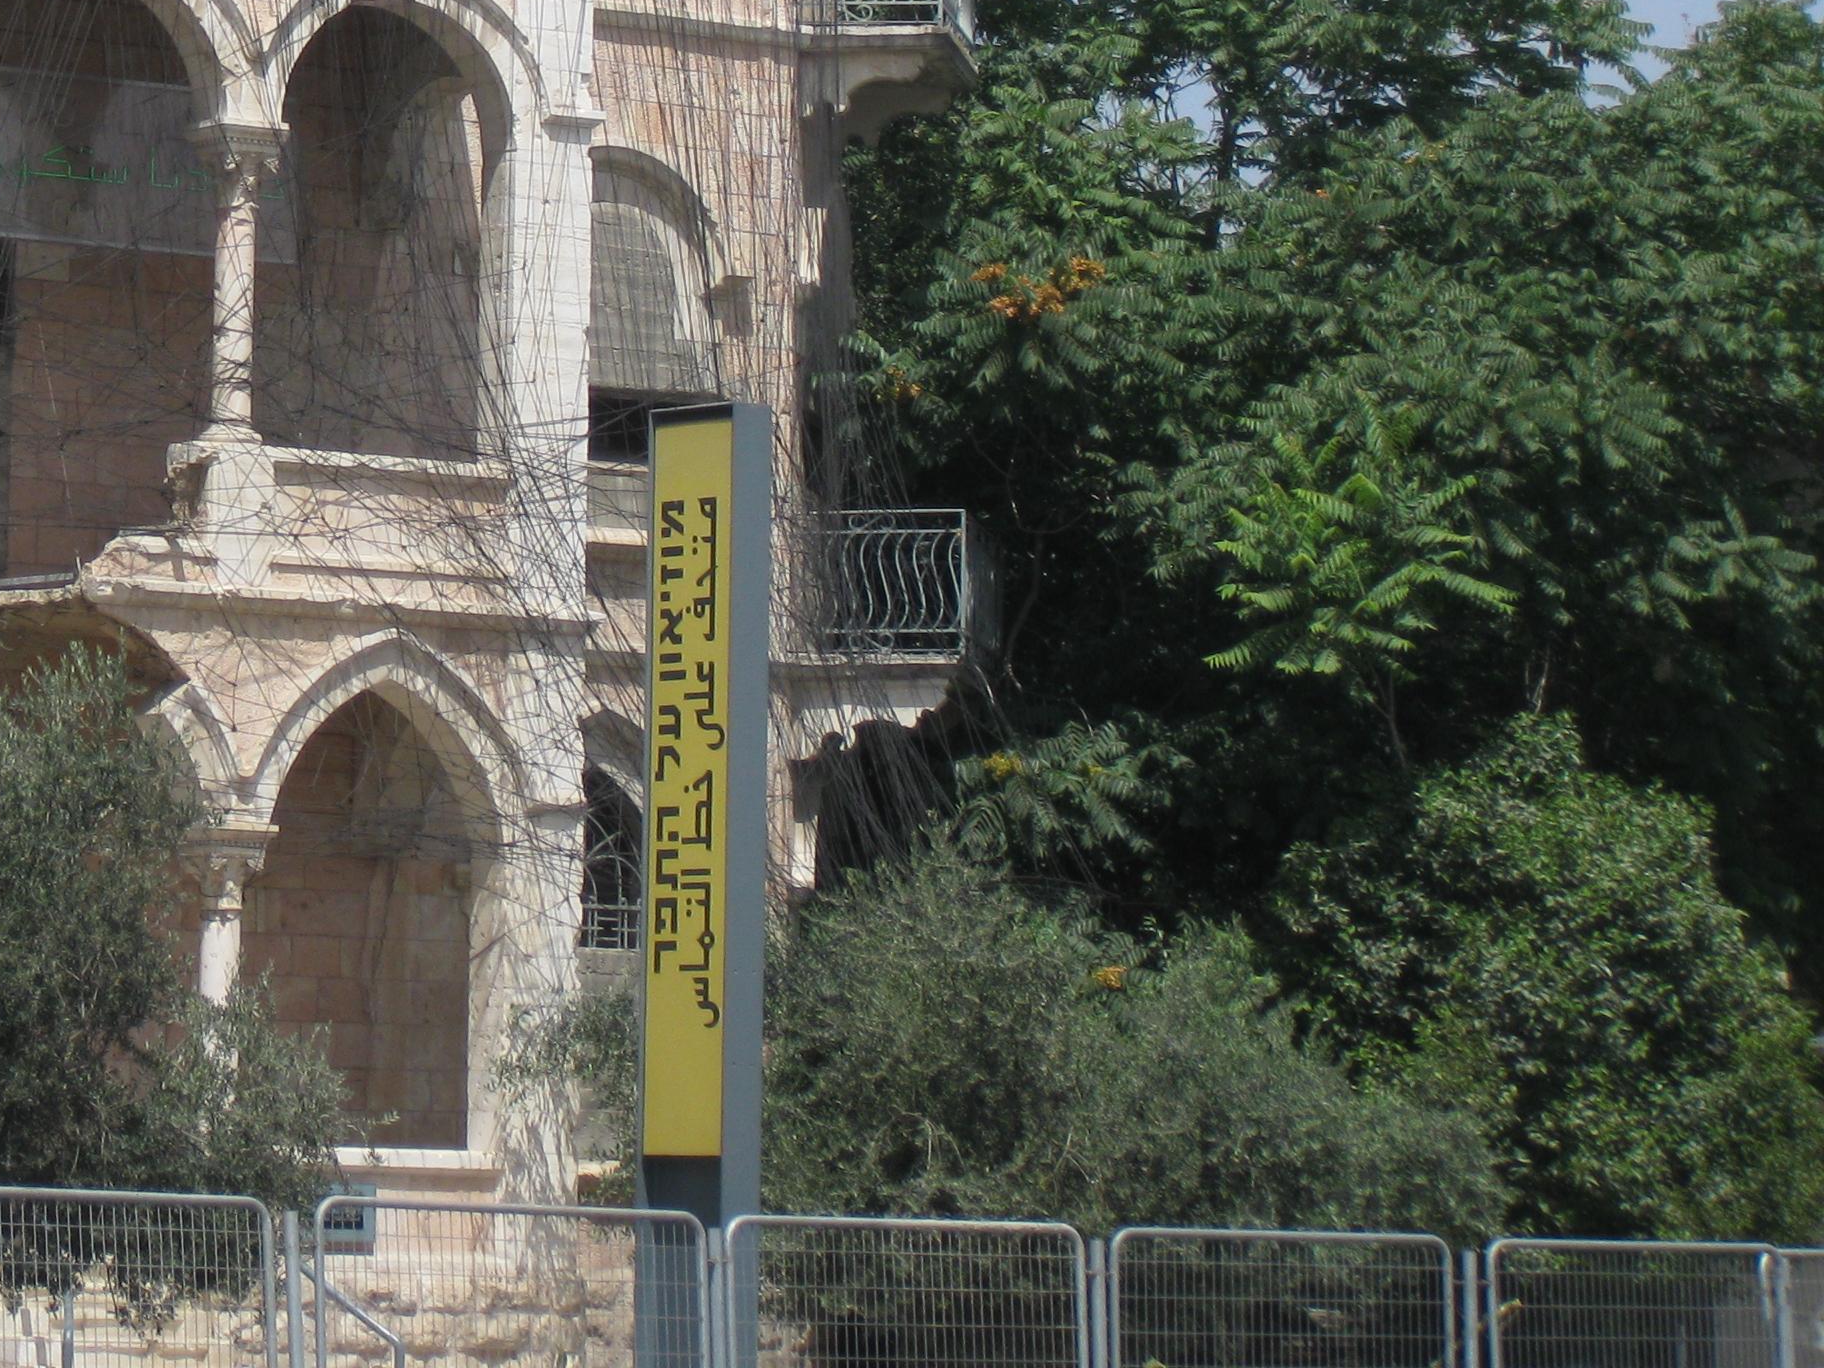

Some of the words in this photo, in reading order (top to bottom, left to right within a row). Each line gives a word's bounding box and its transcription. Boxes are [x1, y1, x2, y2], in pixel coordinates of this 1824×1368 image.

[150, 148, 285, 199] حدنا
[660, 500, 686, 681] מוזיאון
[685, 497, 717, 641] متحف
[656, 704, 682, 781] על
[684, 661, 725, 750] على
[681, 770, 713, 851] خط
[654, 806, 680, 974] התפר
[680, 868, 720, 1028] التماس
